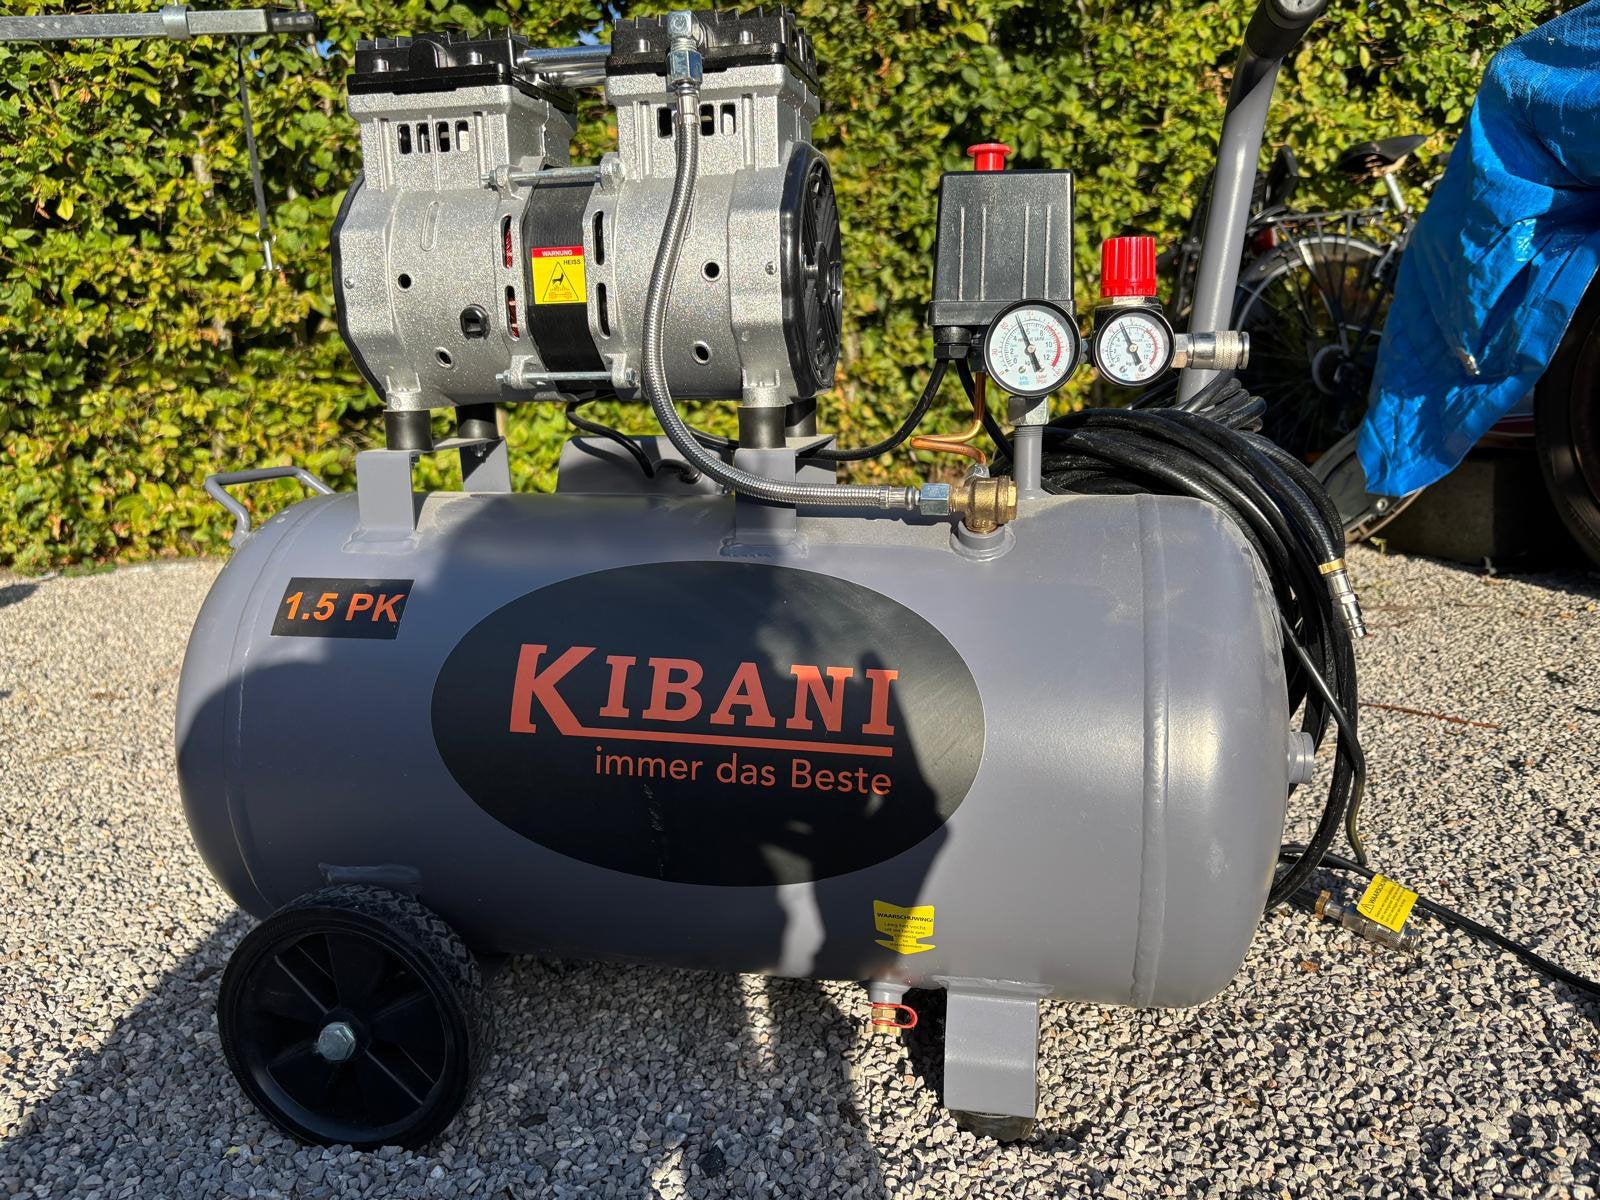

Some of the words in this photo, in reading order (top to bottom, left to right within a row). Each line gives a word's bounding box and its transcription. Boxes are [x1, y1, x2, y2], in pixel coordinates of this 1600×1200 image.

[286, 591, 339, 621] 1.5
[345, 593, 407, 622] PK
[509, 643, 899, 736] KIBANI
[595, 745, 704, 781] immer
[716, 752, 776, 787] das
[790, 758, 893, 796] Beste
